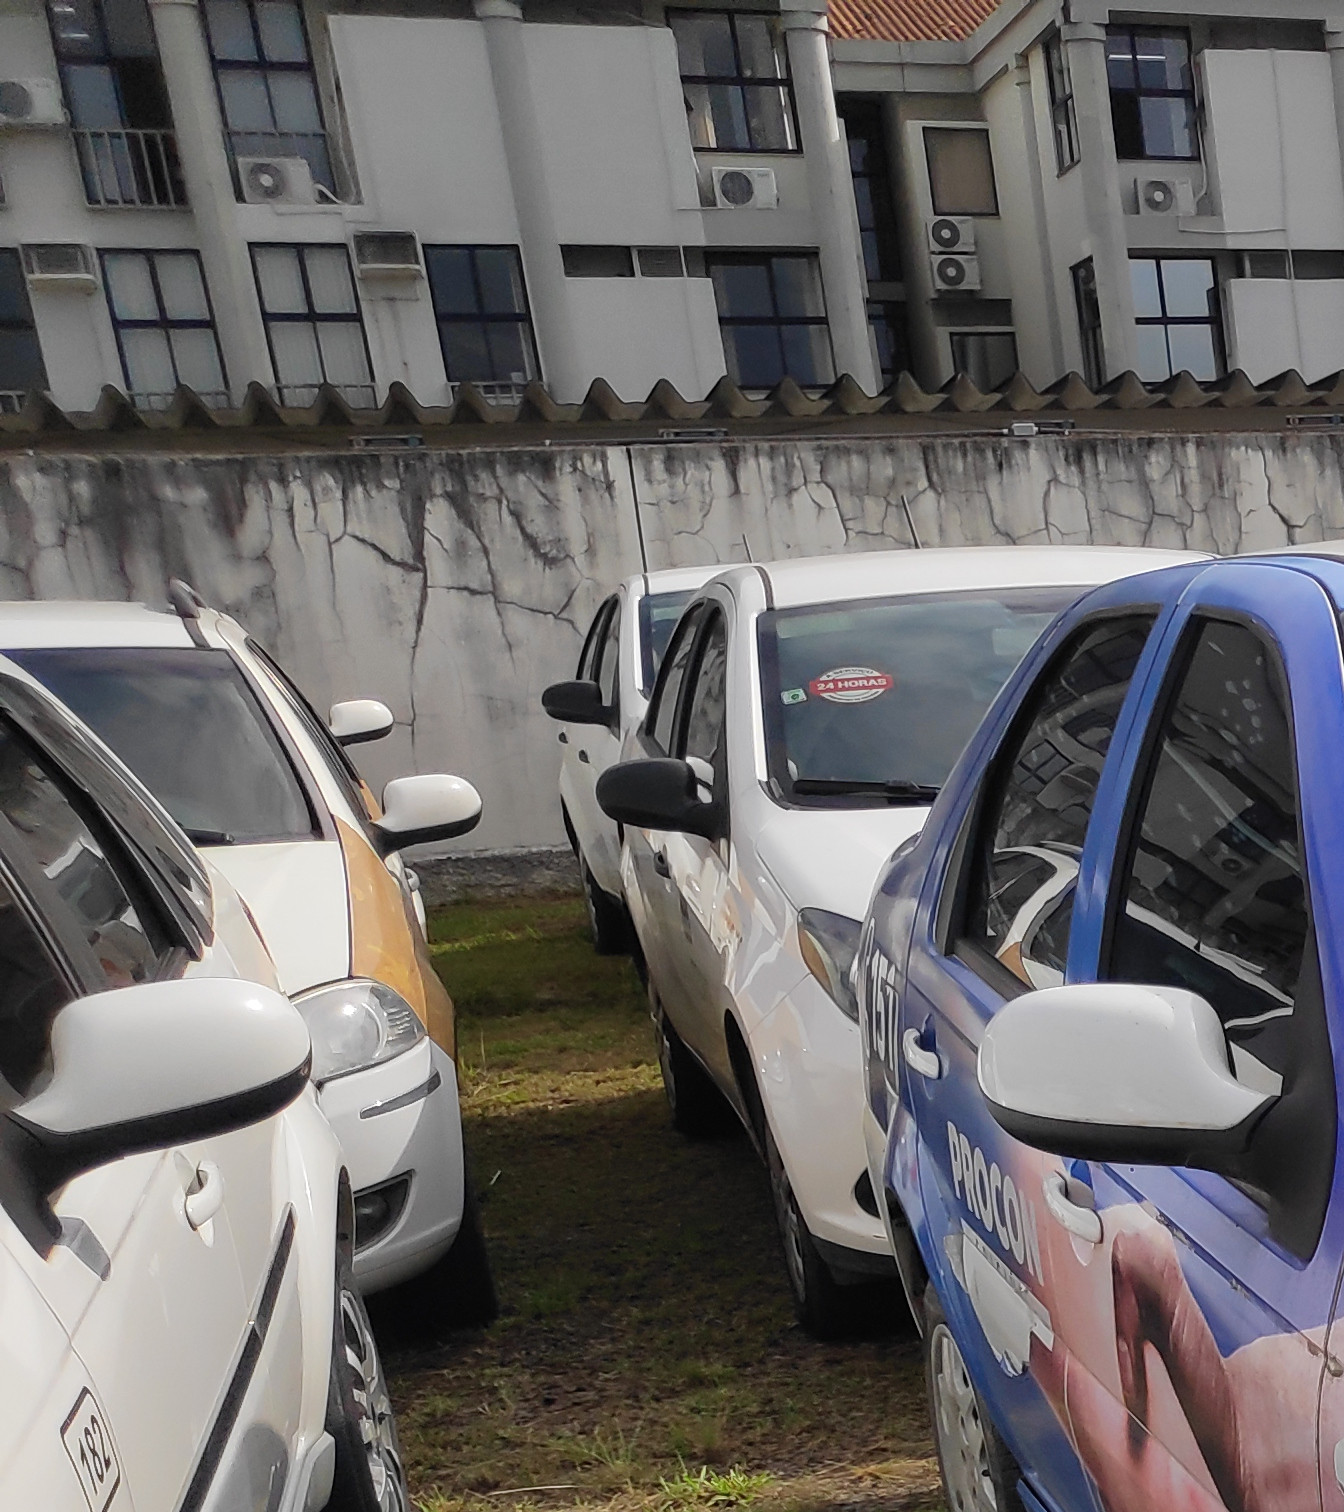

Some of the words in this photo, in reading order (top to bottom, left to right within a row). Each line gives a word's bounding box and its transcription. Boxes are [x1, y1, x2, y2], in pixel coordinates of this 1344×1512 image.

[817, 682, 835, 691] 24
[837, 678, 888, 689] HORAS
[947, 1120, 1045, 1287] PROCON
[78, 1413, 112, 1497] 182
